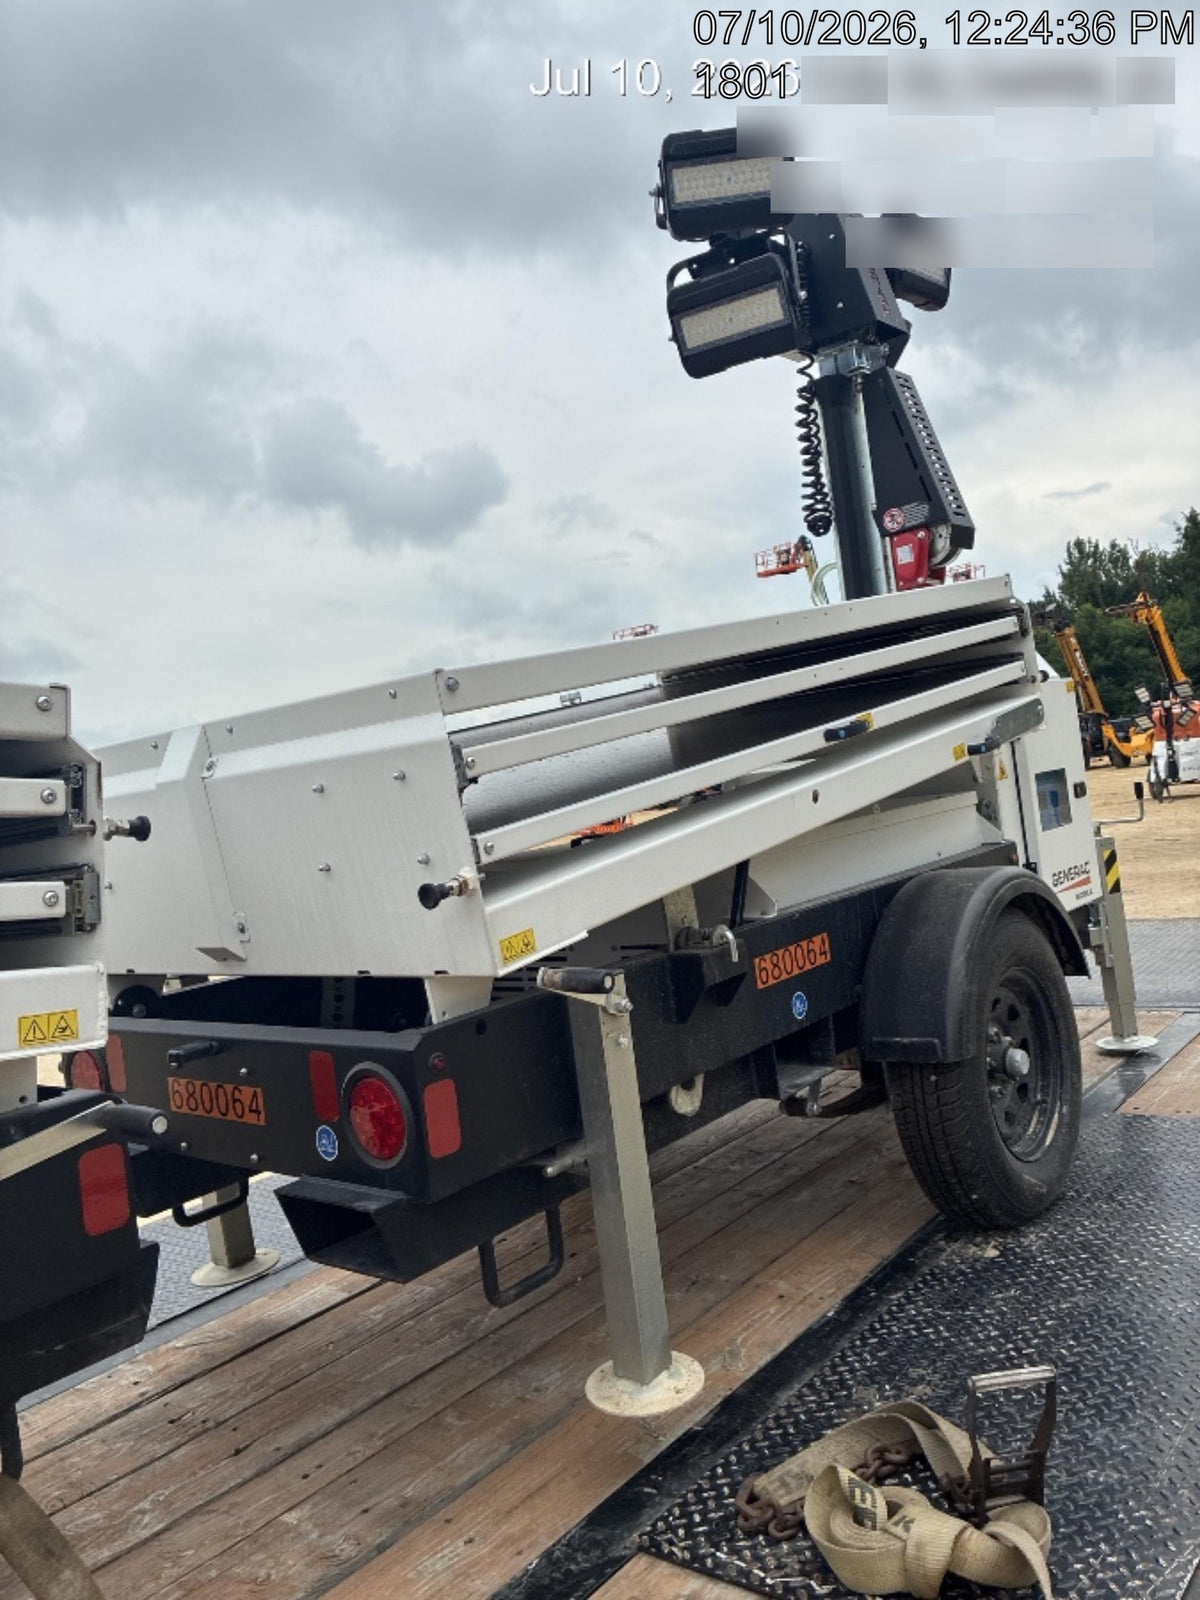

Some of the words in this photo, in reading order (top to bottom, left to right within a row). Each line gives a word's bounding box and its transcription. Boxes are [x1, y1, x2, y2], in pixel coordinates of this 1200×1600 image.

[1052, 861, 1090, 887] GENERAC
[758, 934, 828, 985] 680064
[170, 1078, 262, 1122] 680064
